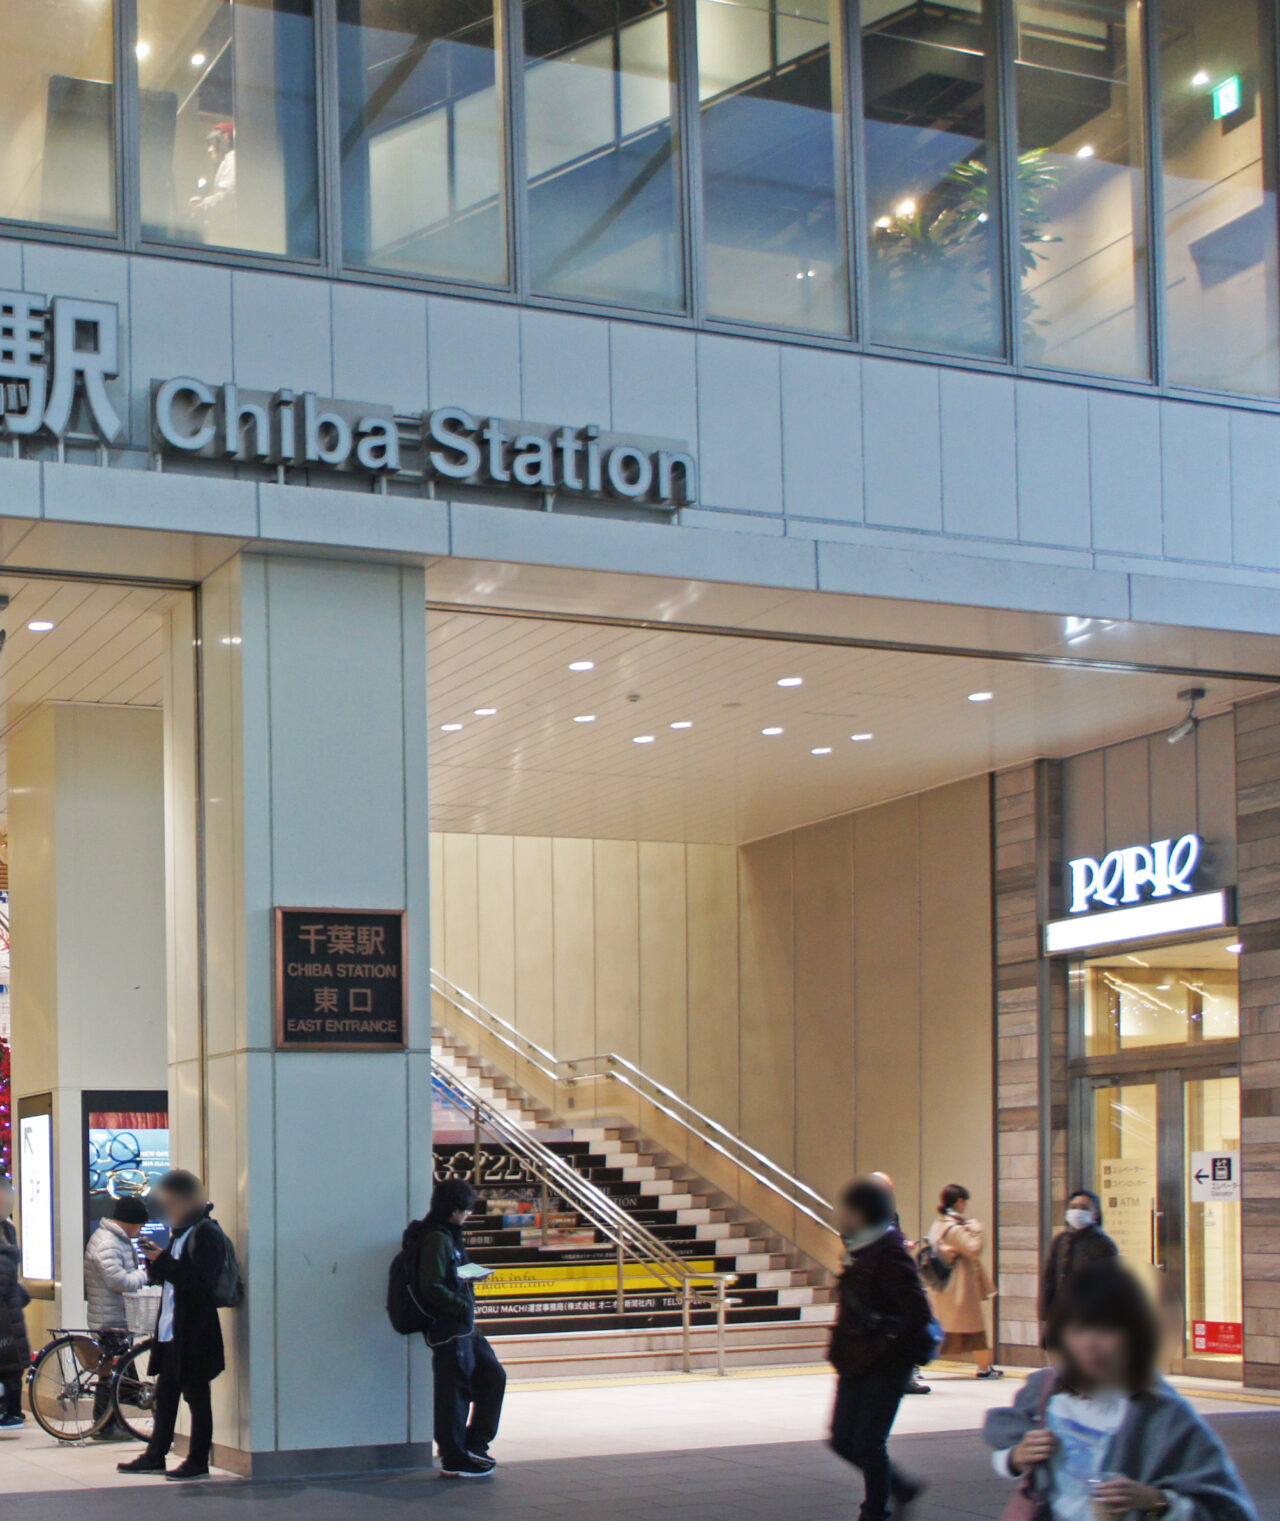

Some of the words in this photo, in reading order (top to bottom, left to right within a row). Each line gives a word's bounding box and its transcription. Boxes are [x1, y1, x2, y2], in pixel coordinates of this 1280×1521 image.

[154, 375, 401, 472] Chiba
[428, 406, 698, 505] Station
[298, 924, 385, 956] 千葉駅
[287, 962, 333, 977] CHIBA
[336, 964, 397, 978] STATION
[313, 987, 372, 1013] 東口
[287, 1019, 323, 1032] EAST
[325, 1019, 398, 1033] ENTRANCE
[1120, 1196, 1140, 1208] ATM
